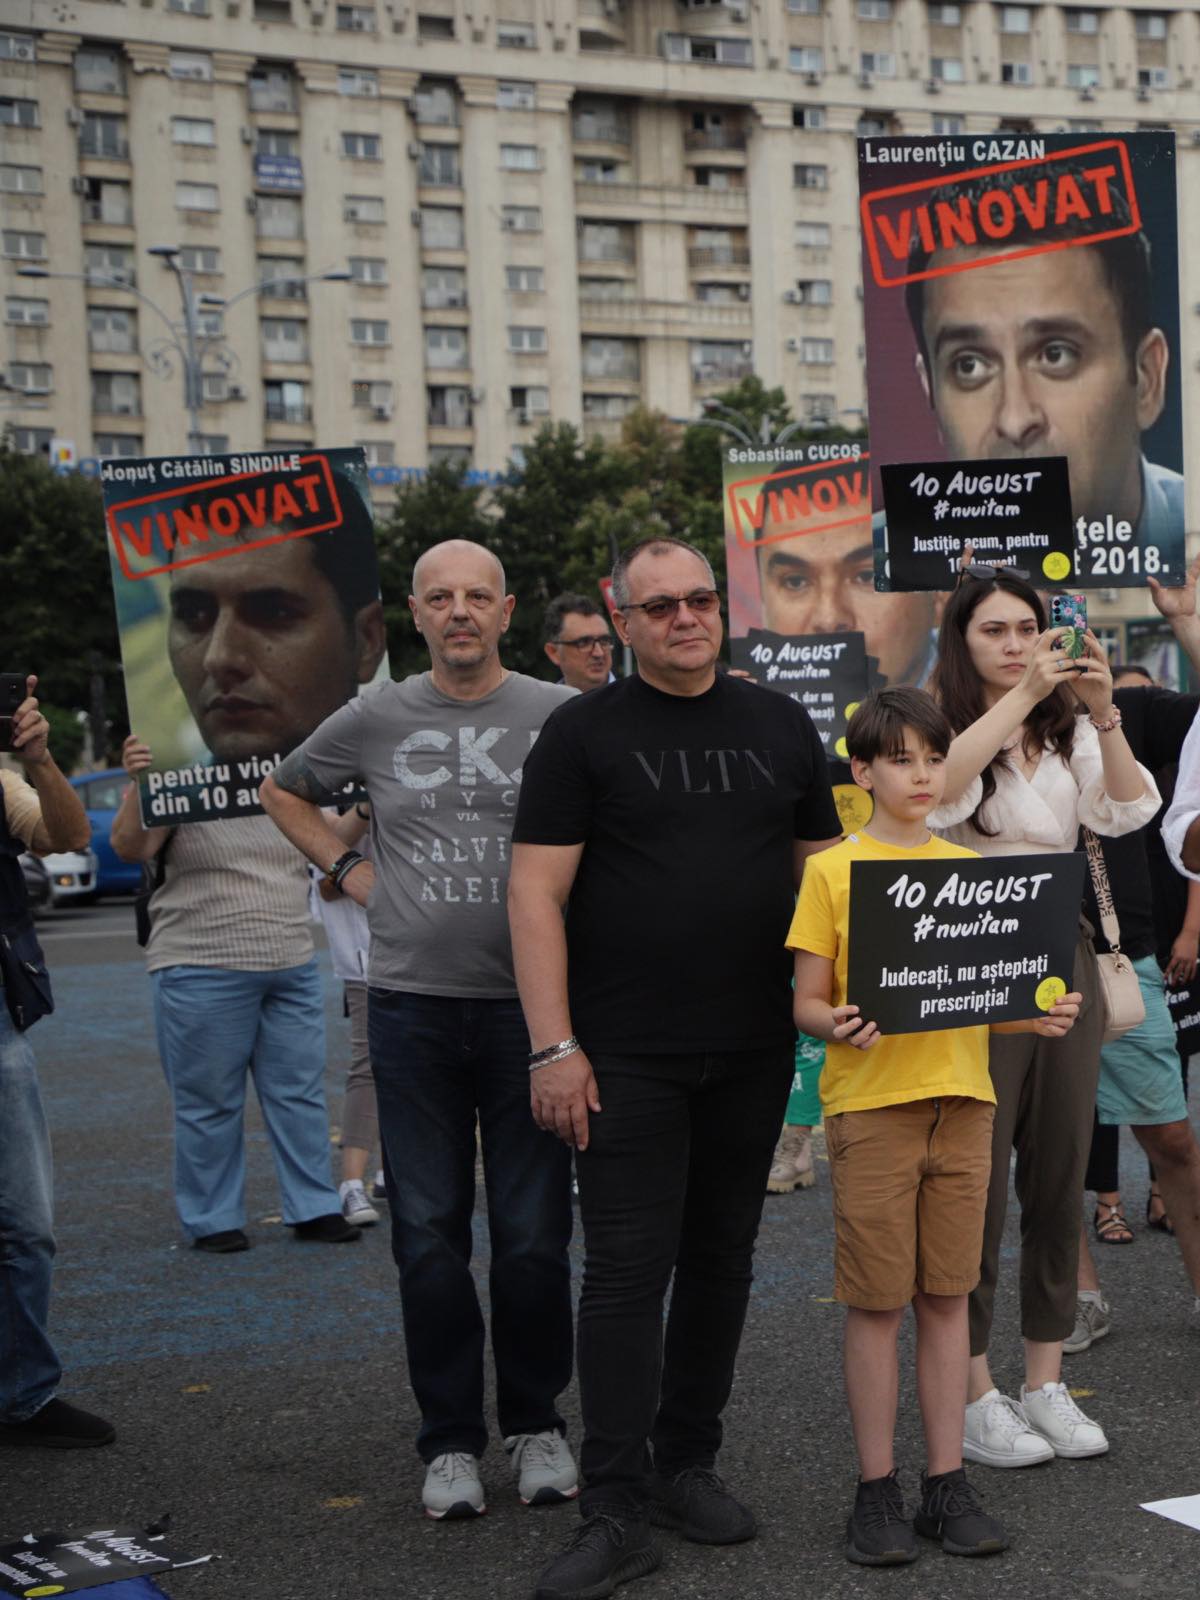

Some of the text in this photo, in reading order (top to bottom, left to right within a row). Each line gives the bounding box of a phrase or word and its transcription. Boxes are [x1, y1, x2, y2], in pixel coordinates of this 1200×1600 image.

[972, 140, 1045, 161] CAZAN
[876, 165, 1116, 260] VINOVAT
[161, 459, 225, 478] Cătălin
[230, 454, 301, 474] SINDILE
[728, 447, 803, 463] Sebastian
[909, 470, 1042, 497] 10 AUGUST
[739, 470, 862, 529] VINOV
[121, 474, 321, 557] VINOVAT
[913, 535, 960, 556] Justiție
[1006, 532, 1049, 551] pentru
[1091, 546, 1169, 575] 2018.
[750, 642, 847, 663] 10 AUGUST
[148, 763, 230, 795] pentru
[630, 749, 776, 792] VLTN
[151, 792, 190, 816] din
[199, 786, 228, 810] 10
[456, 812, 480, 821] VIA
[412, 837, 506, 863] CALVI
[421, 876, 499, 903] KLEI
[887, 872, 1052, 908] 10 AUGUST
[880, 954, 1048, 990] Judecați, nu așteptați
[920, 986, 1009, 1018] prescripția!
